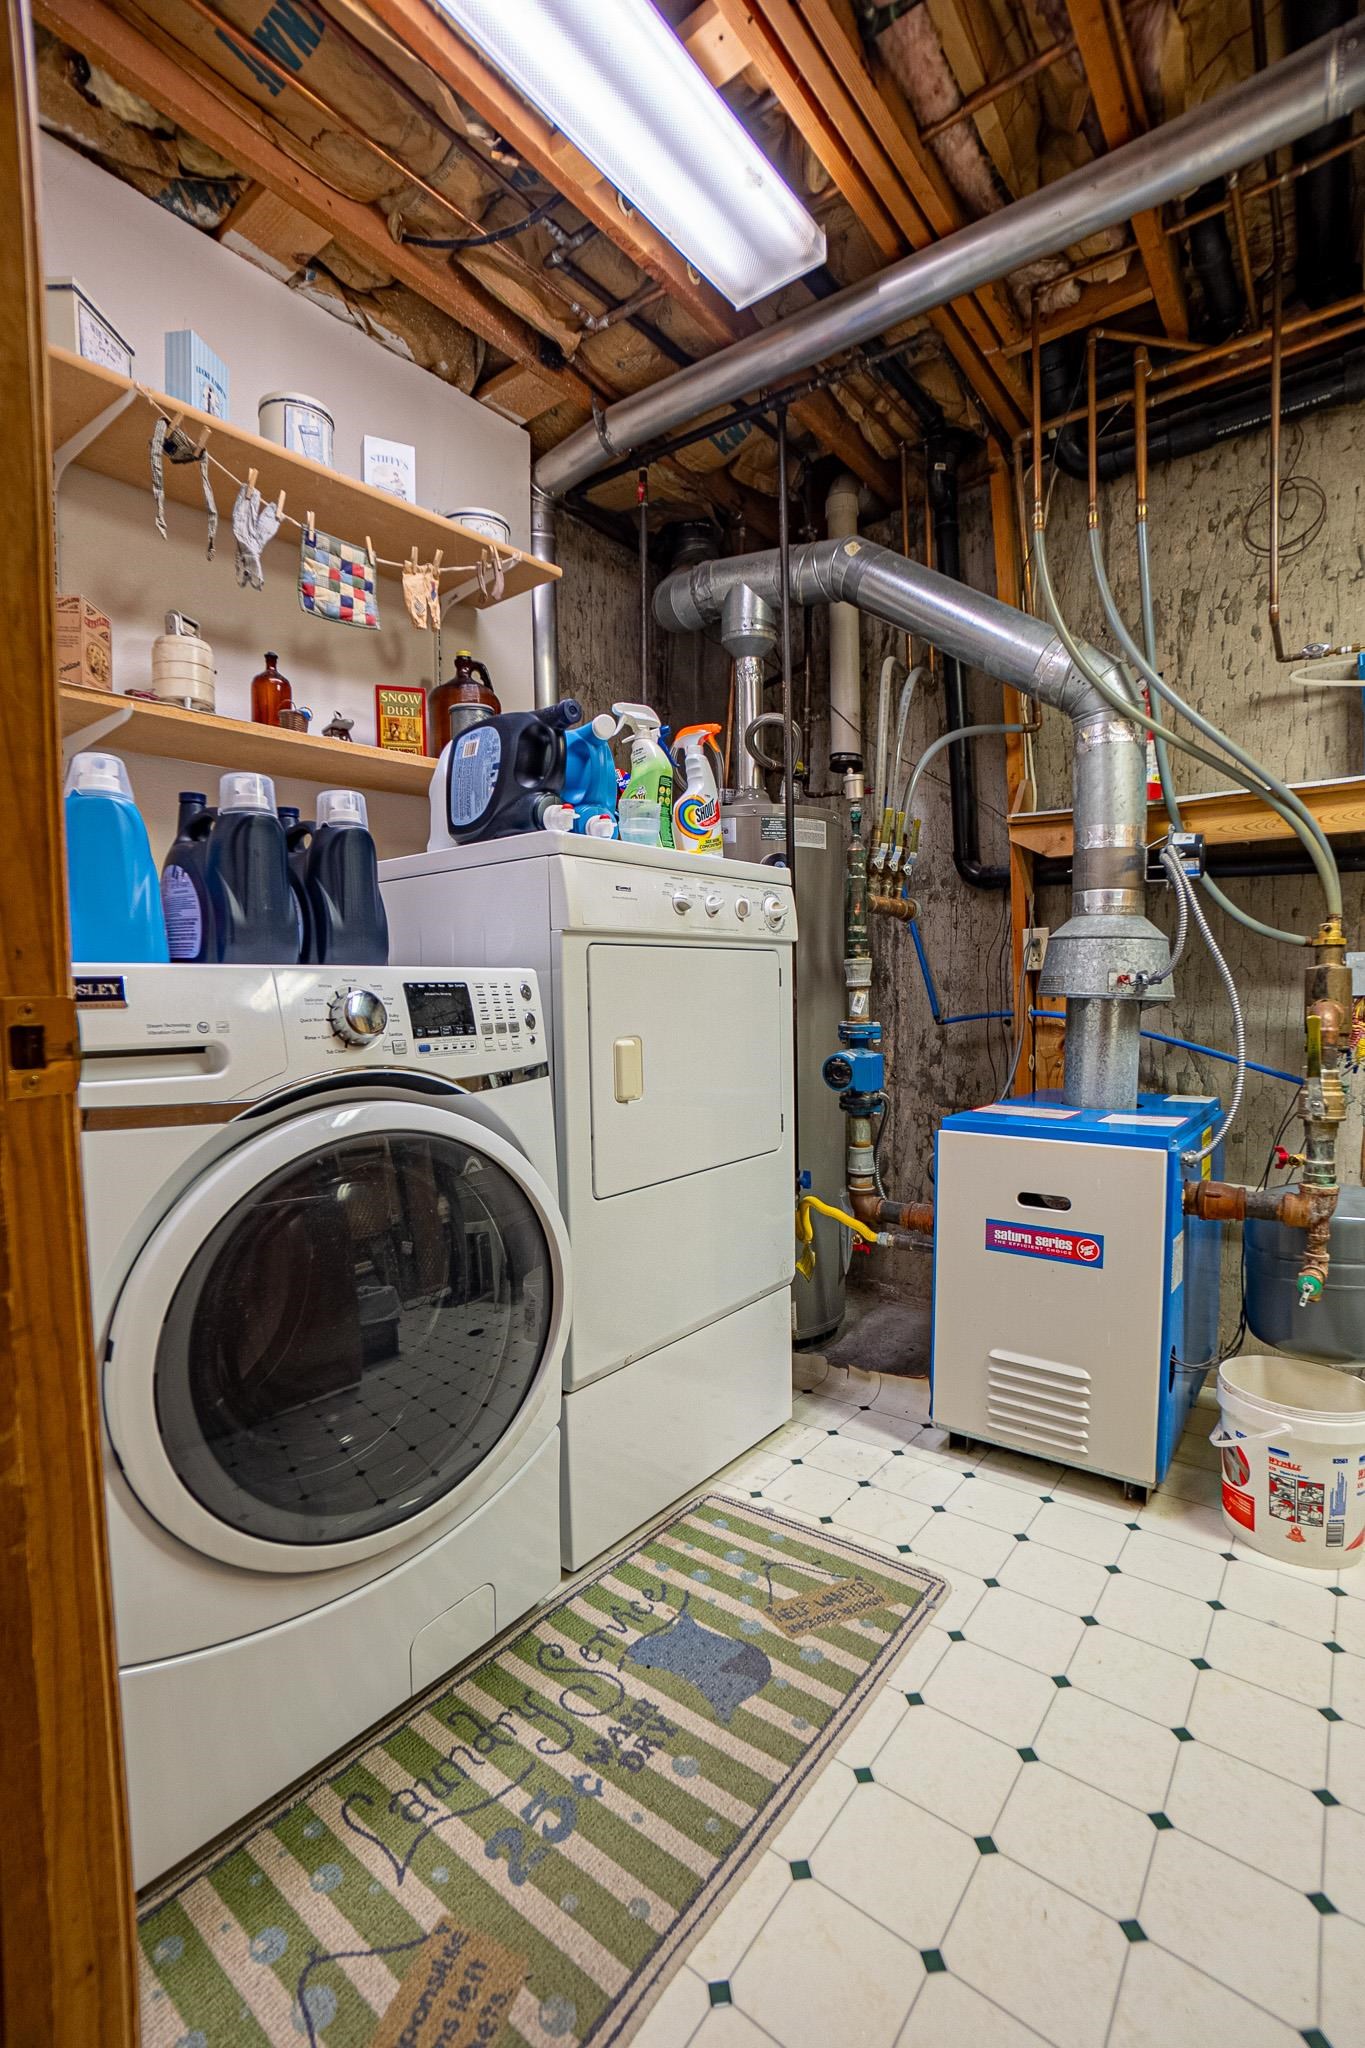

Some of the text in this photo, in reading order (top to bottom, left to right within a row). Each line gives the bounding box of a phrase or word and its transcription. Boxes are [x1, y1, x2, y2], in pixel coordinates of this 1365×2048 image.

[381, 692, 421, 705] SNOW
[387, 705, 416, 717] DUST
[695, 797, 716, 823] SHOUT
[73, 983, 120, 996] SLEY
[994, 1229, 1073, 1251] saturn series
[1009, 1241, 1044, 1251] EFFICIENT
[1046, 1247, 1072, 1256] CHOICE
[341, 1582, 669, 1887] Laundry Service
[618, 1714, 678, 1774] DRY
